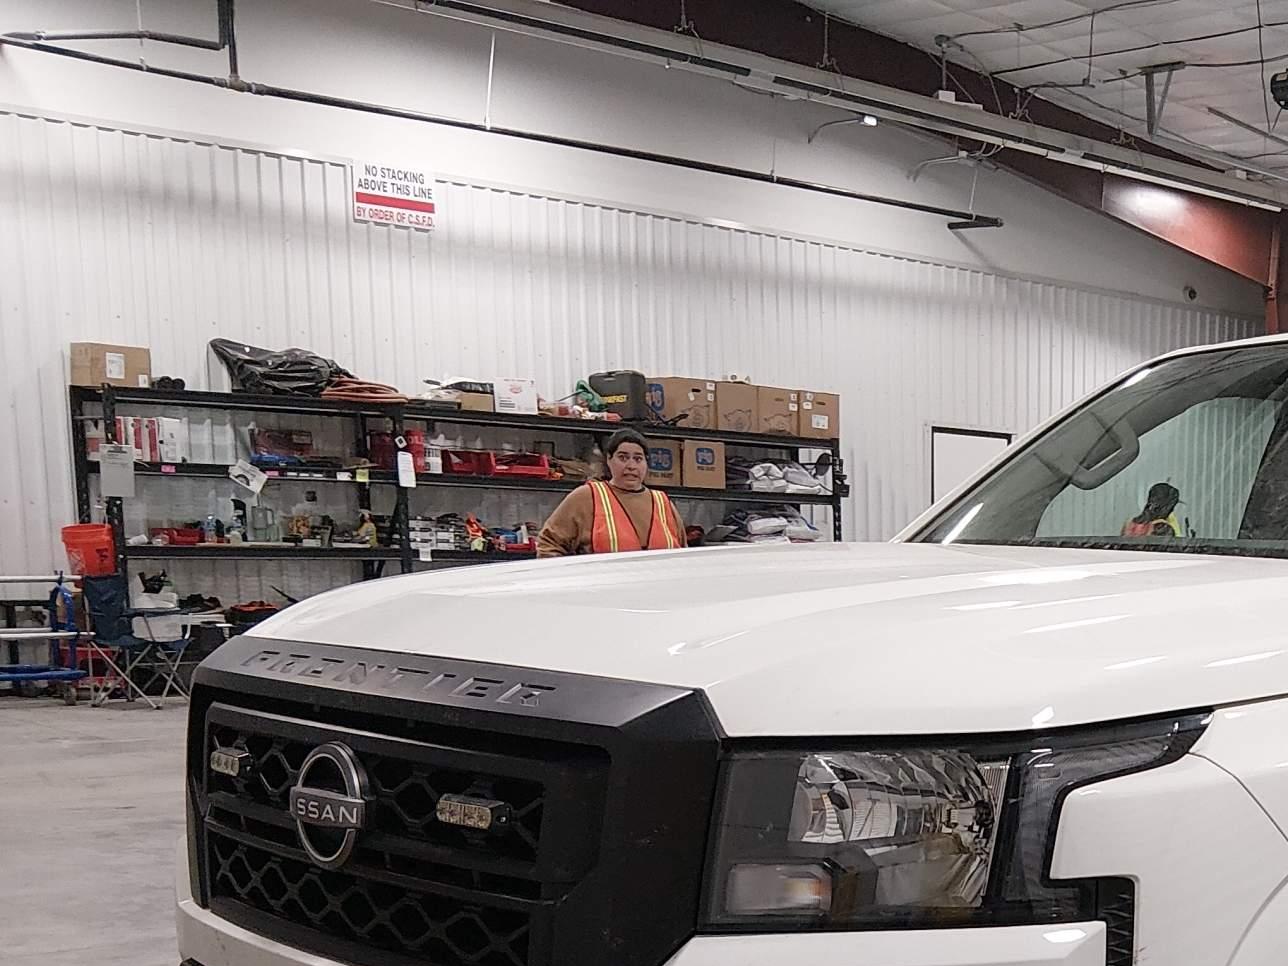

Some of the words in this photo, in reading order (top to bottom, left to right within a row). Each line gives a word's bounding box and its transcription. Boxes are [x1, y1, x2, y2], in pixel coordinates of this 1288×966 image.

[364, 164, 378, 177] NO
[380, 167, 425, 184] STACKING
[357, 178, 388, 193] ABOVE
[391, 182, 410, 196] THIS
[413, 186, 433, 200] LINE
[356, 206, 367, 217] BY
[368, 208, 394, 222] ORDER
[396, 211, 406, 223] OF
[240, 650, 557, 706] FRONTIER
[296, 797, 358, 824] SSAN
